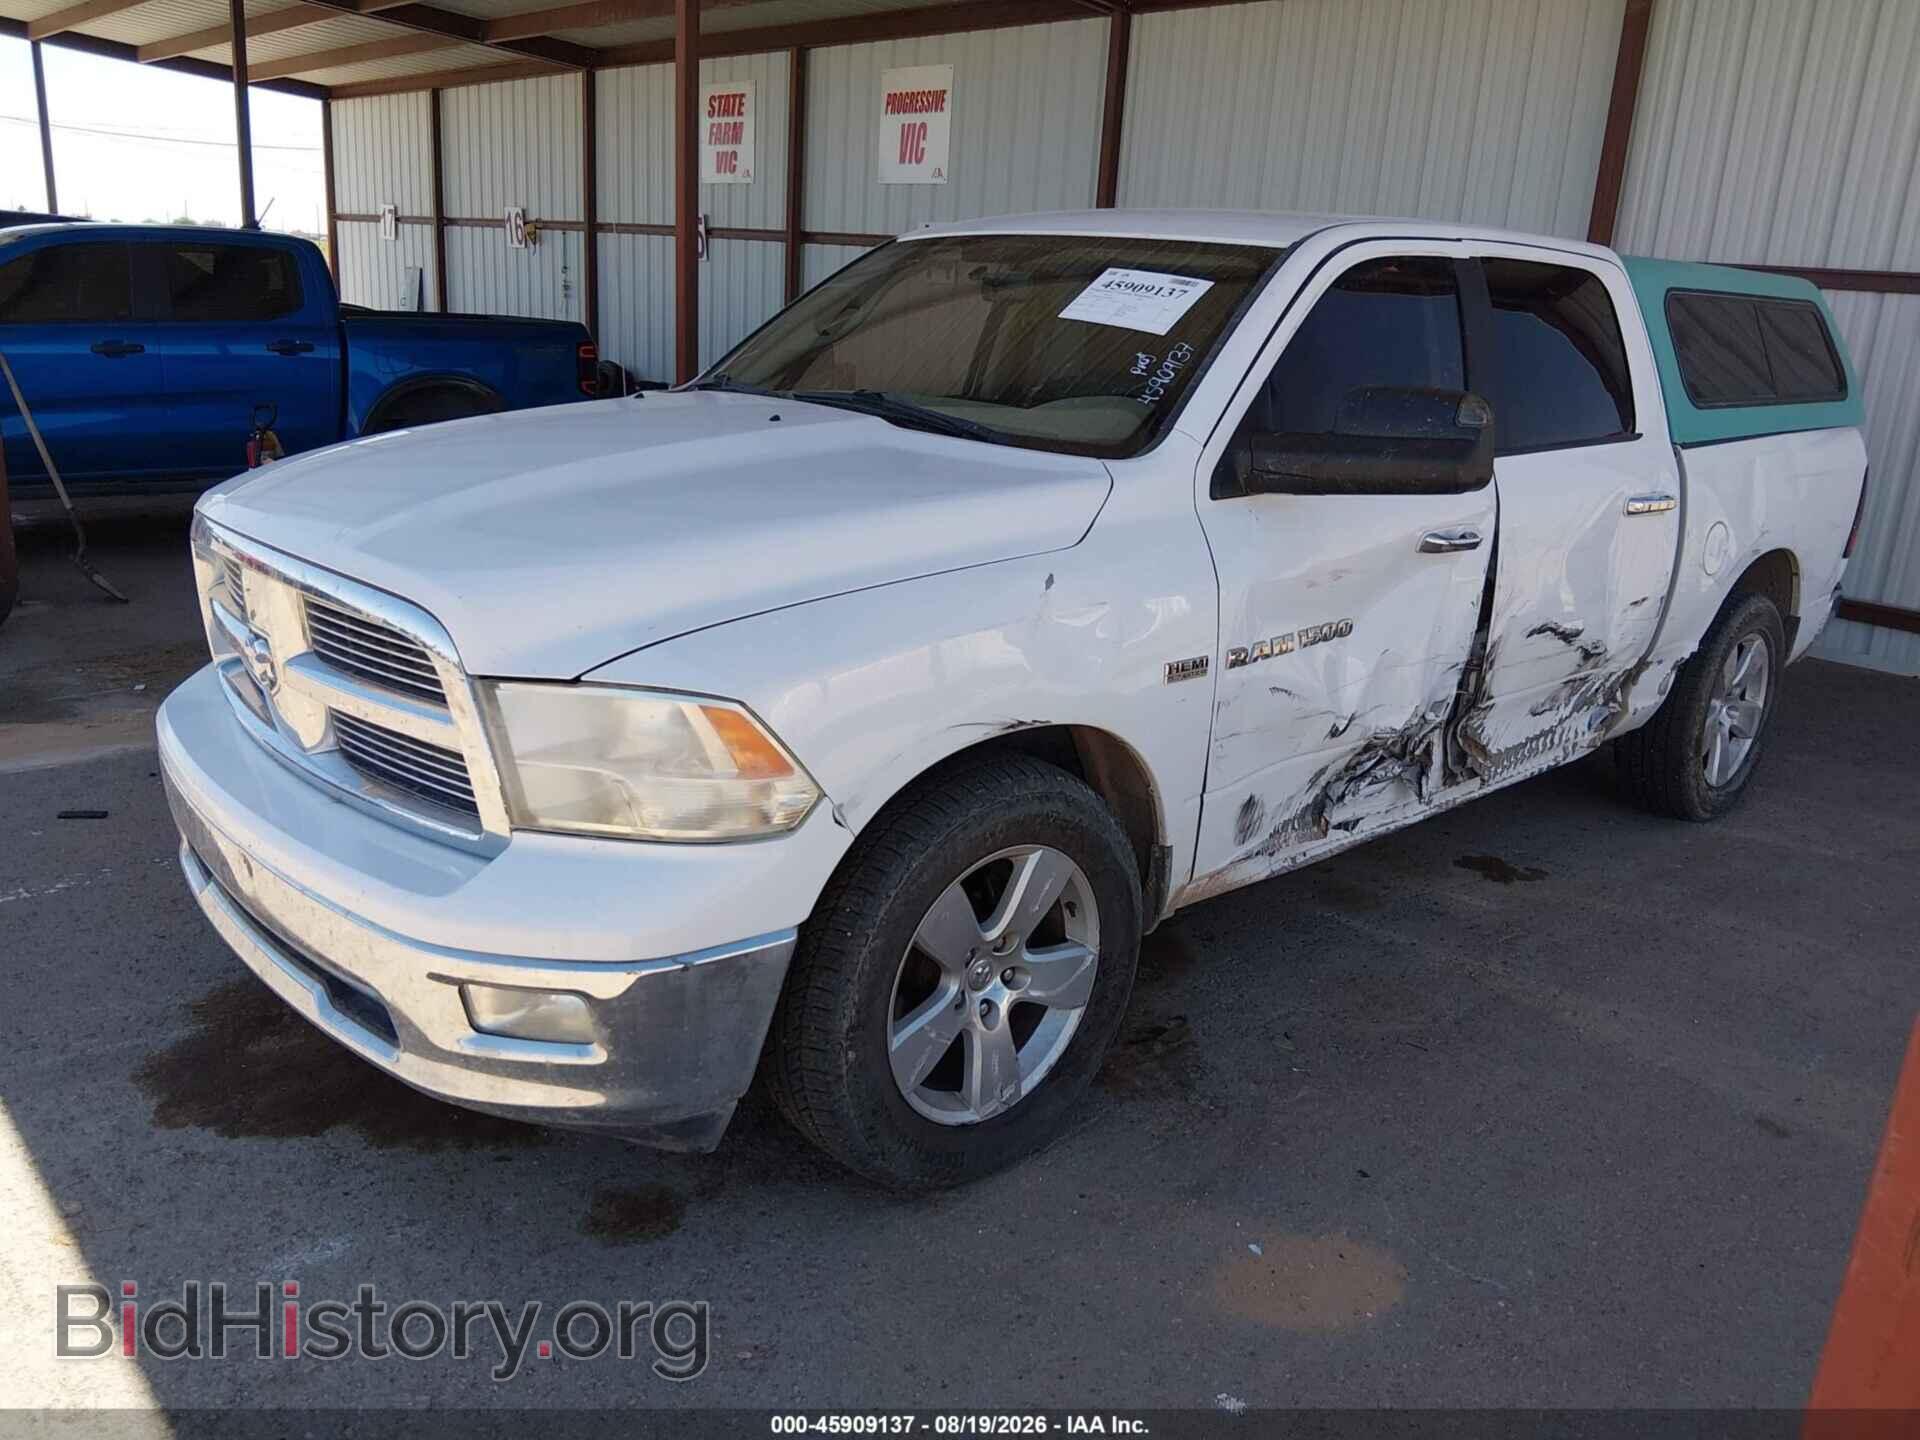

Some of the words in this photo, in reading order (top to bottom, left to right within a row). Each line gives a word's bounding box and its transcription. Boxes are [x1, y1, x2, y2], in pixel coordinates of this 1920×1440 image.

[707, 93, 746, 119] STATE
[885, 89, 947, 116] PROGRESSIVE
[708, 121, 745, 146] FARM
[898, 121, 928, 166] VIC
[714, 150, 738, 175] VIC
[382, 207, 394, 237] 17
[505, 210, 524, 246] 16
[1101, 279, 1190, 299] 45909137
[1136, 342, 1195, 405] 45909137
[1225, 633, 1295, 669] RAM
[1297, 618, 1354, 649] 1500
[1166, 655, 1209, 676] HEMI
